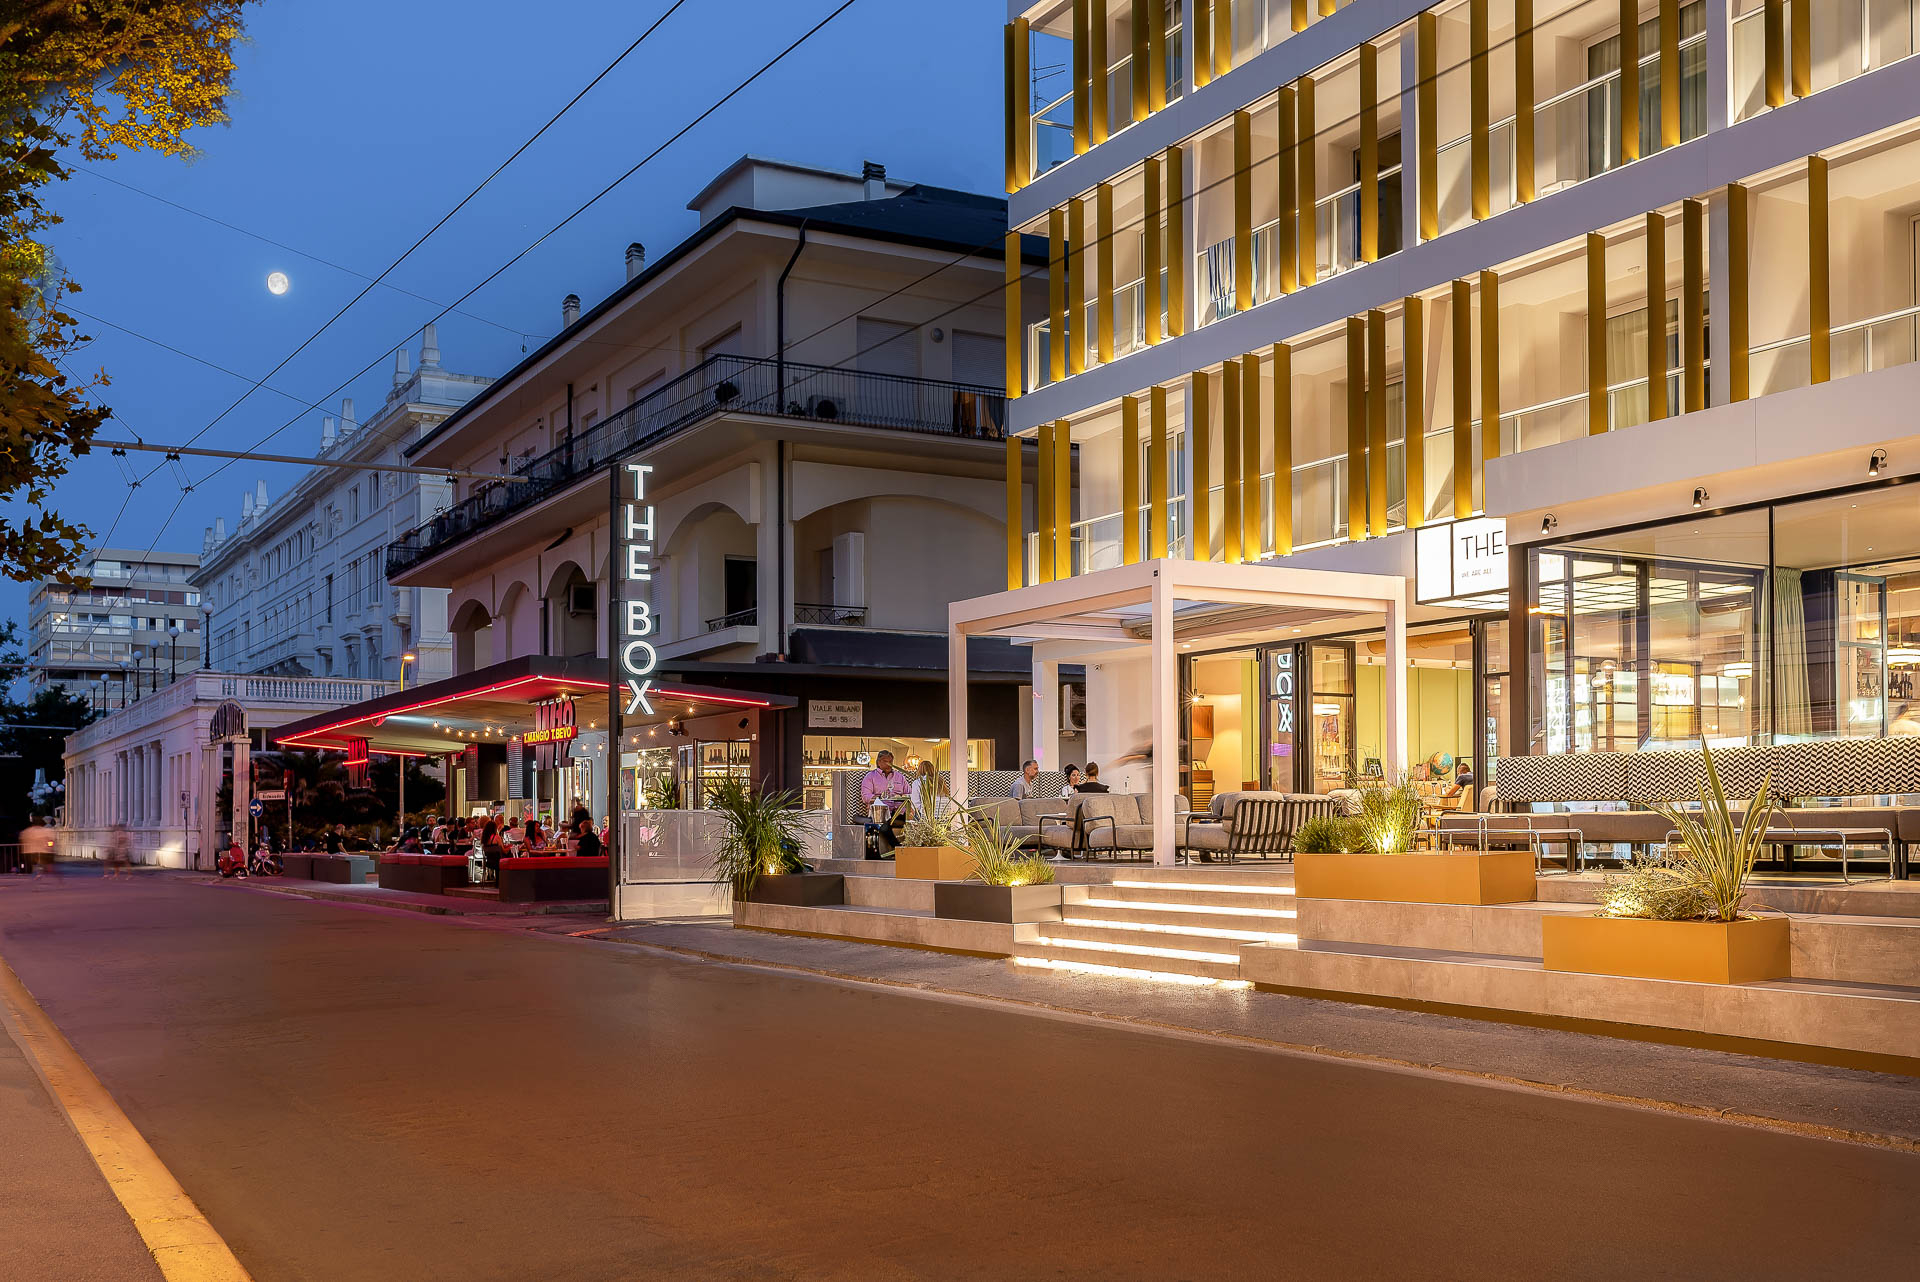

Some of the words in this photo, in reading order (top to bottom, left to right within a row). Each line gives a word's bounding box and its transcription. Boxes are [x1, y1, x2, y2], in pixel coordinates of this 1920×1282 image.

[625, 464, 654, 582] THE
[1460, 530, 1504, 560] THE
[622, 600, 657, 716] BOX
[811, 704, 832, 712] VIALE
[551, 726, 572, 740] T.BEVO
